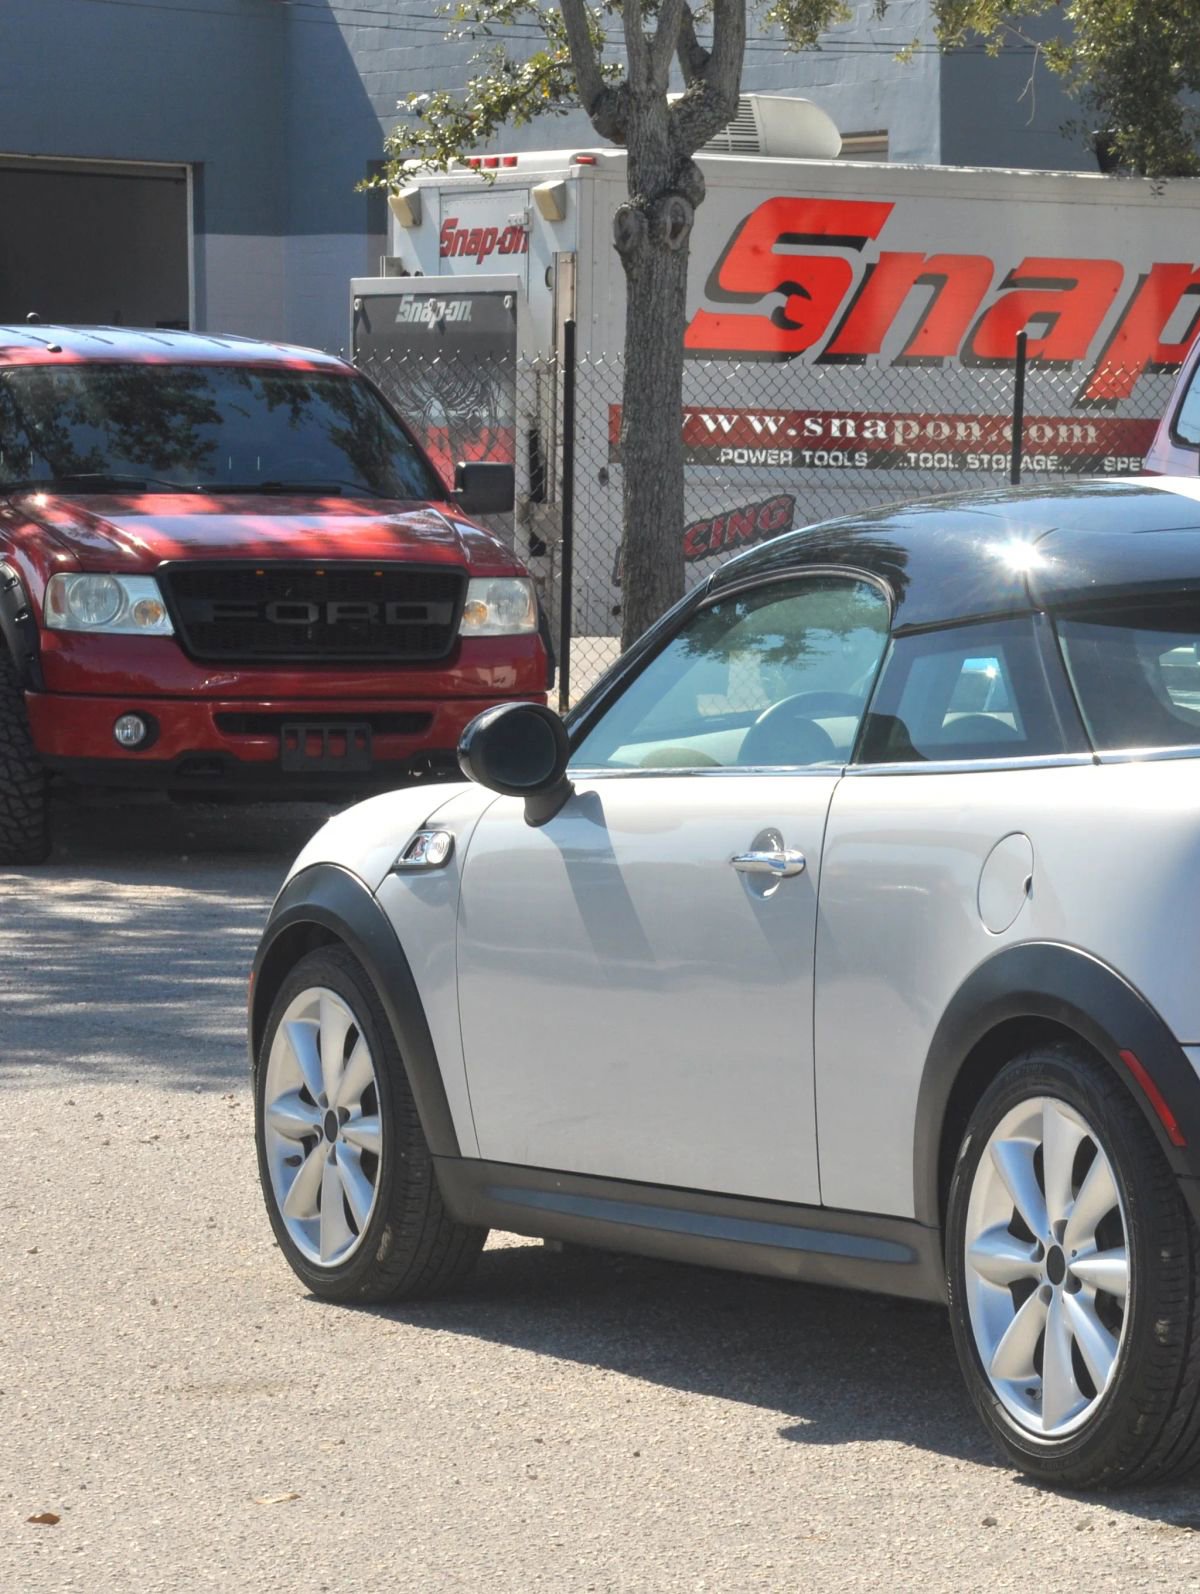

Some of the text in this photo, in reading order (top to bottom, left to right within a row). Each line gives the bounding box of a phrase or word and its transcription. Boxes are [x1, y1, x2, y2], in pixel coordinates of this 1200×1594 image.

[440, 217, 529, 265] Snap-on
[395, 294, 472, 329] Snap-on
[682, 412, 1097, 447] ww.snapon.com
[802, 450, 868, 467] TOOLS
[183, 600, 454, 625] FORD
